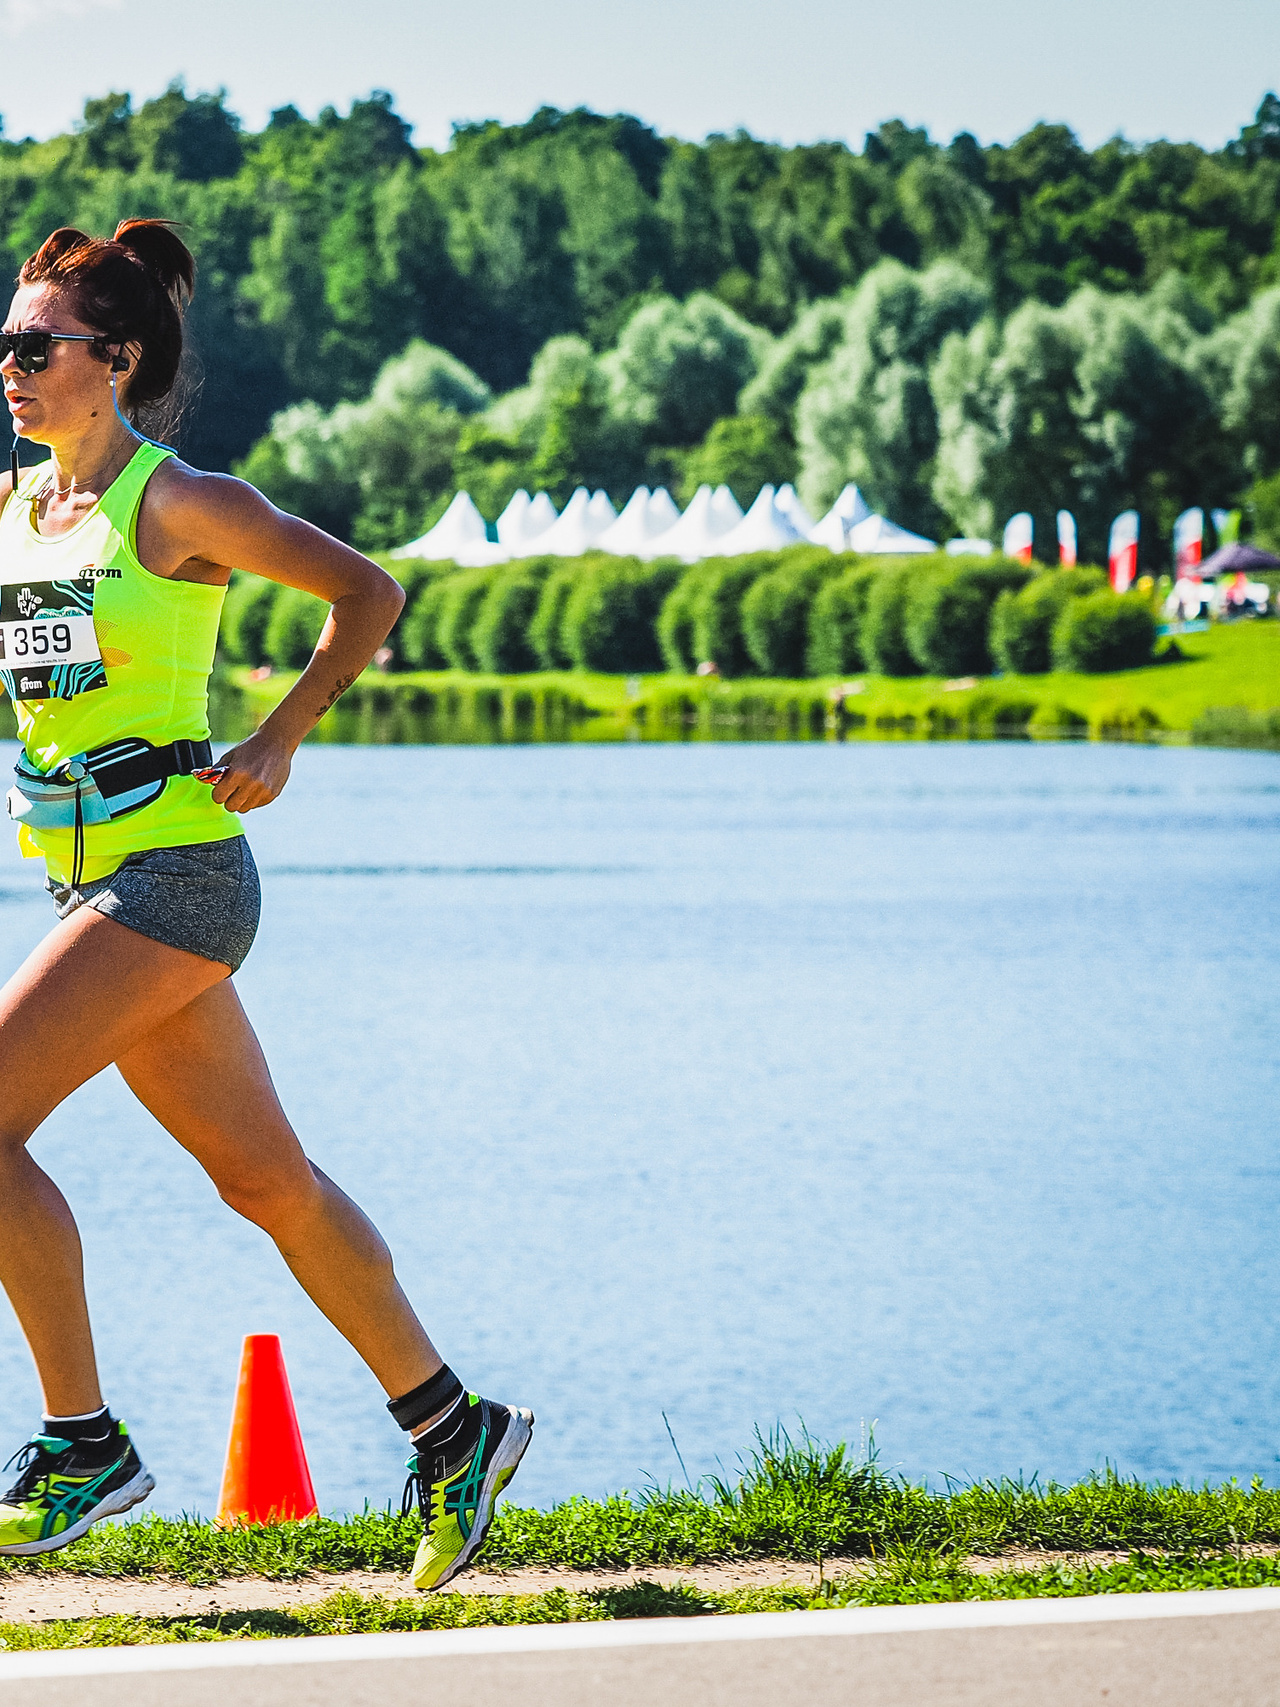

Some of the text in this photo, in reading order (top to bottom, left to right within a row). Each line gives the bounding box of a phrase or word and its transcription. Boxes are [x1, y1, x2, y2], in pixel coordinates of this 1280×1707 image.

[79, 568, 122, 580] grom
[14, 624, 71, 656] 359
[20, 678, 43, 693] grom
